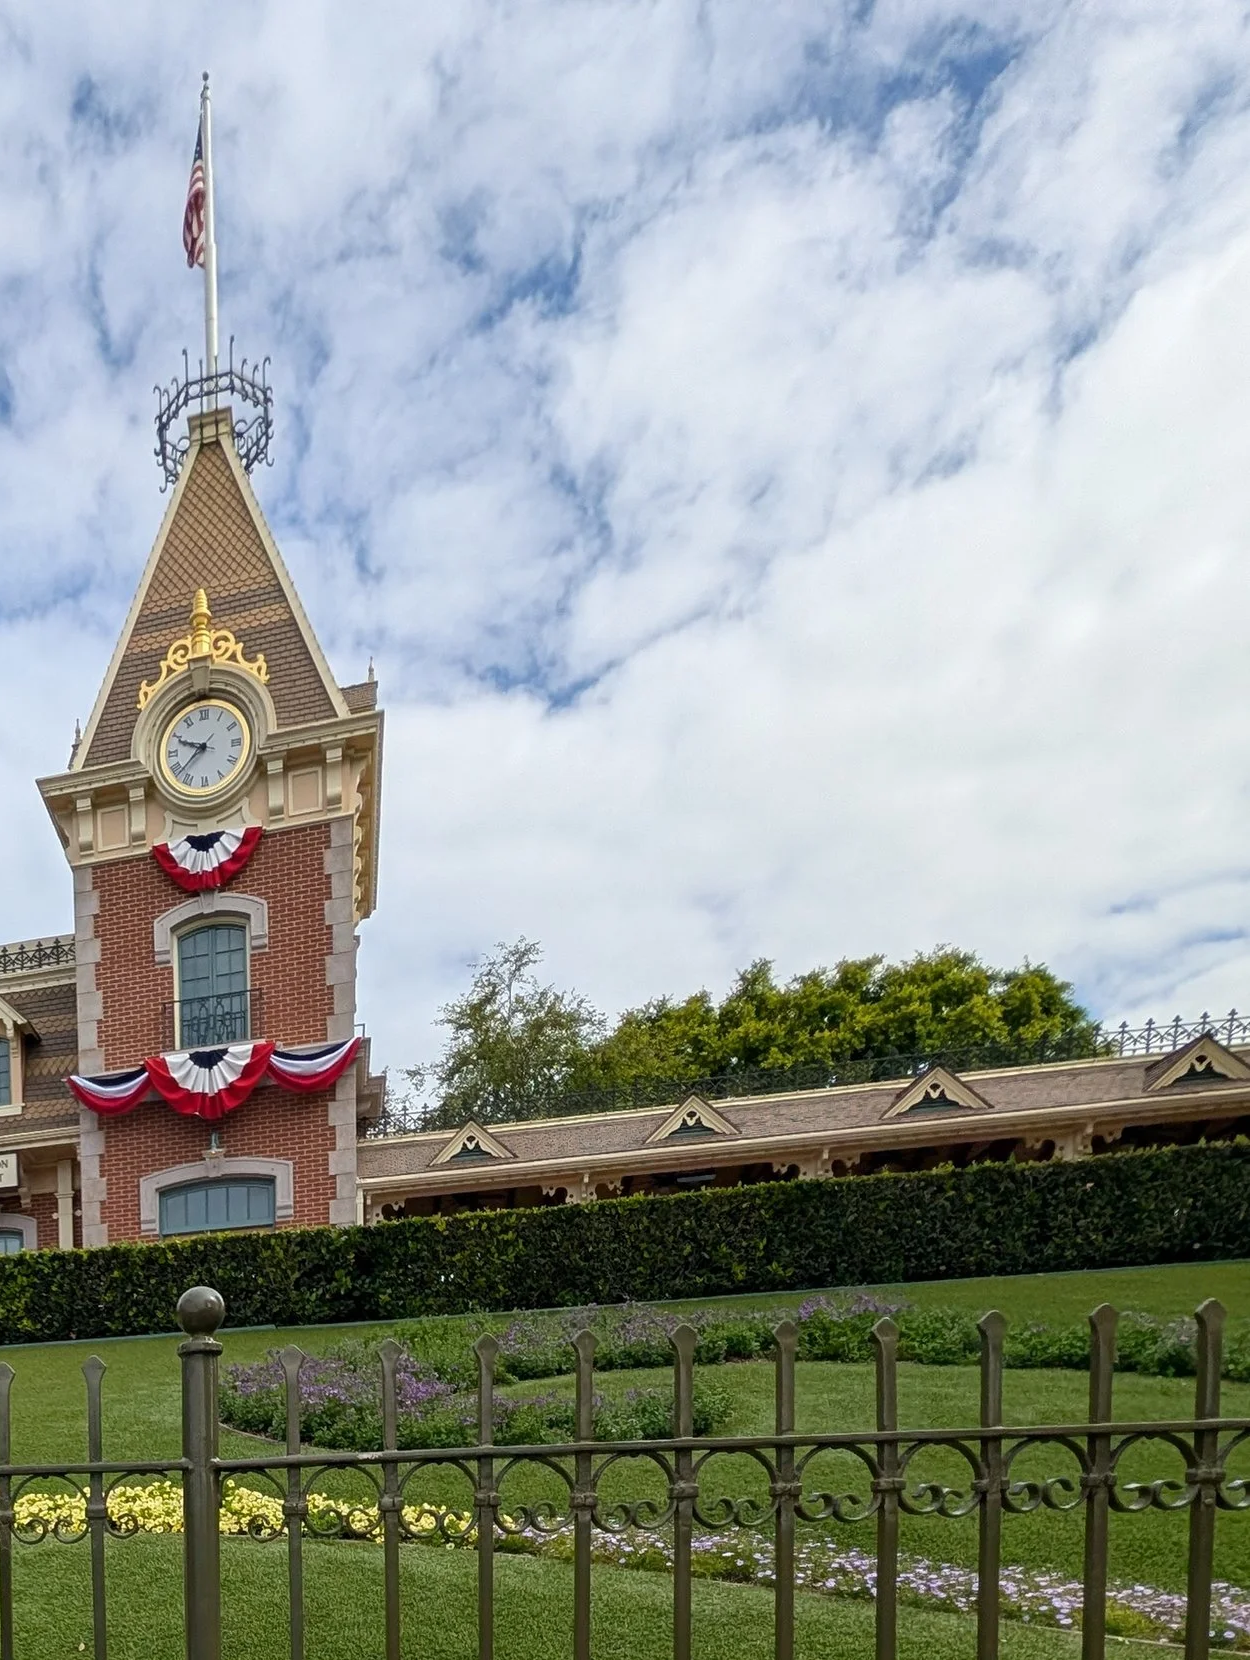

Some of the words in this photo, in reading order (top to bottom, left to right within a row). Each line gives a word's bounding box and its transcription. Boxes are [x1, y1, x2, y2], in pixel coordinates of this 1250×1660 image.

[199, 708, 210, 721] XII
[217, 711, 224, 721] I
[183, 716, 194, 729] XI
[226, 721, 237, 731] II
[230, 737, 242, 748] III
[182, 772, 195, 786] VII
[200, 775, 210, 787] VI
